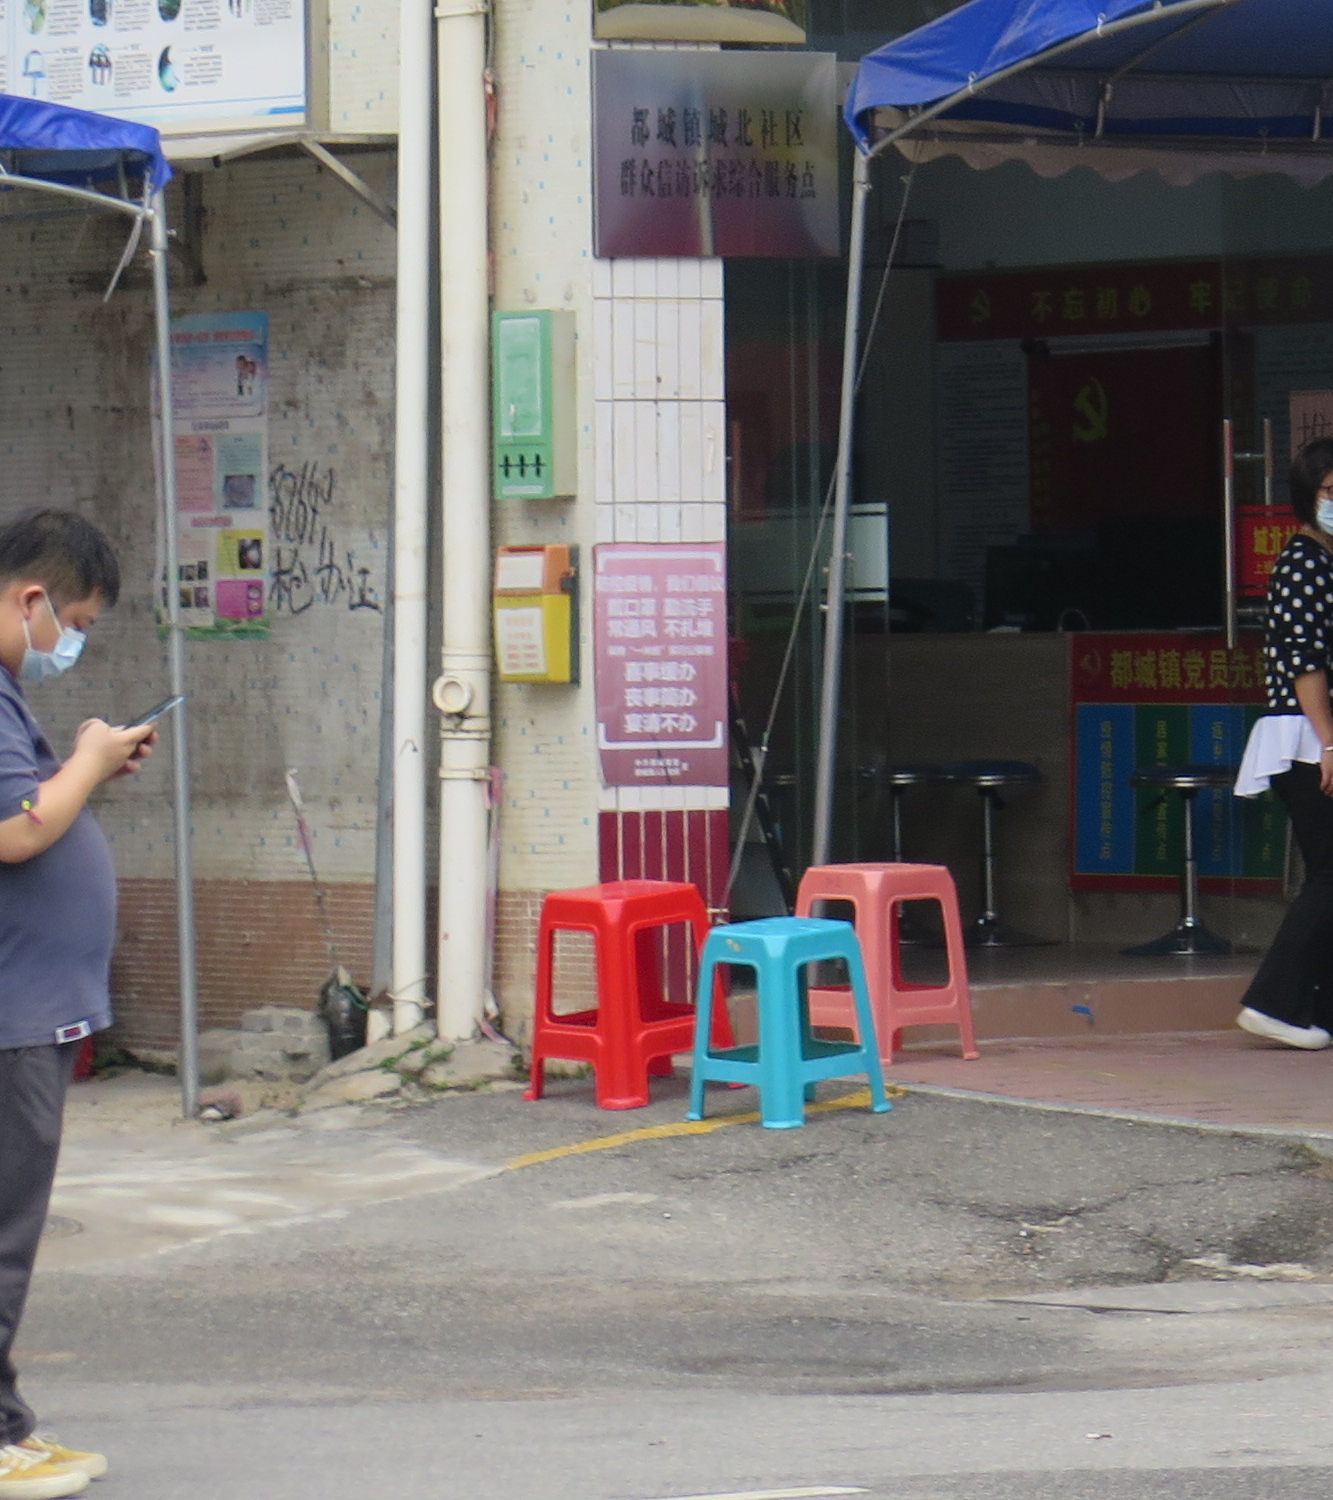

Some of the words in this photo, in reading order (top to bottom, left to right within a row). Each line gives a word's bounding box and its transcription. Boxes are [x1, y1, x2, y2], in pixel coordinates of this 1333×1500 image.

[630, 106, 805, 149] 都城镇城北社区
